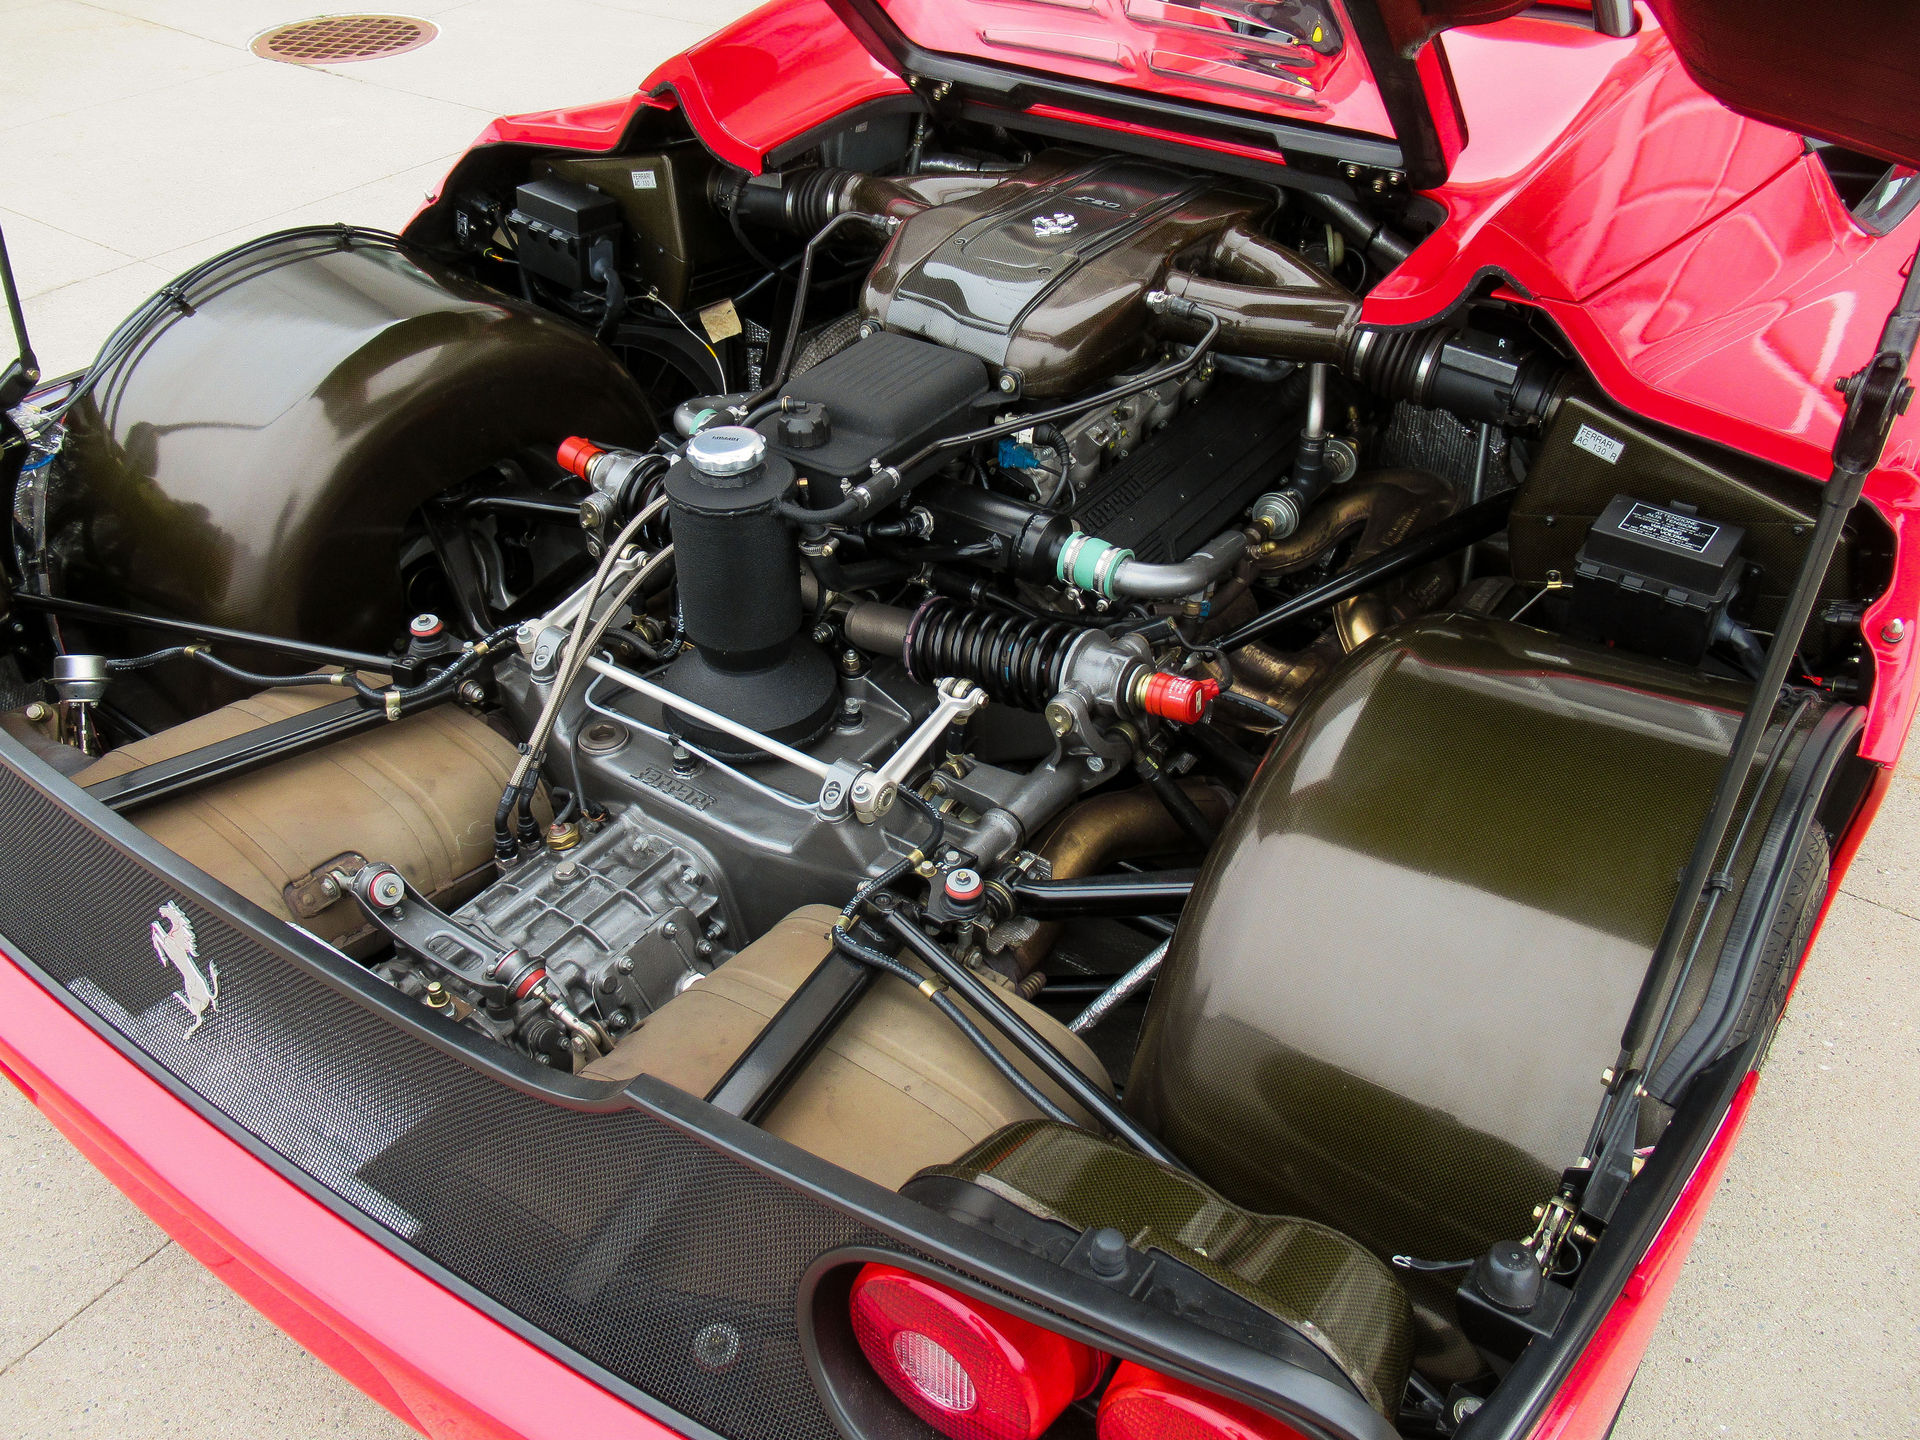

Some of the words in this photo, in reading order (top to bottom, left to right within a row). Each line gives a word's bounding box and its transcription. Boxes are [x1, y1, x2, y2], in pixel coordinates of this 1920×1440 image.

[1498, 338, 1506, 348] R
[1576, 436, 1589, 446] AC
[1592, 444, 1607, 456] 130
[1610, 453, 1617, 461] R
[1580, 428, 1615, 450] FERRARI
[1646, 512, 1662, 520] ALTA
[1665, 518, 1700, 531] TENSIONE
[1650, 523, 1683, 536] WARNING
[1660, 530, 1690, 542] VOLTAGE
[842, 883, 876, 917] SILICONE
